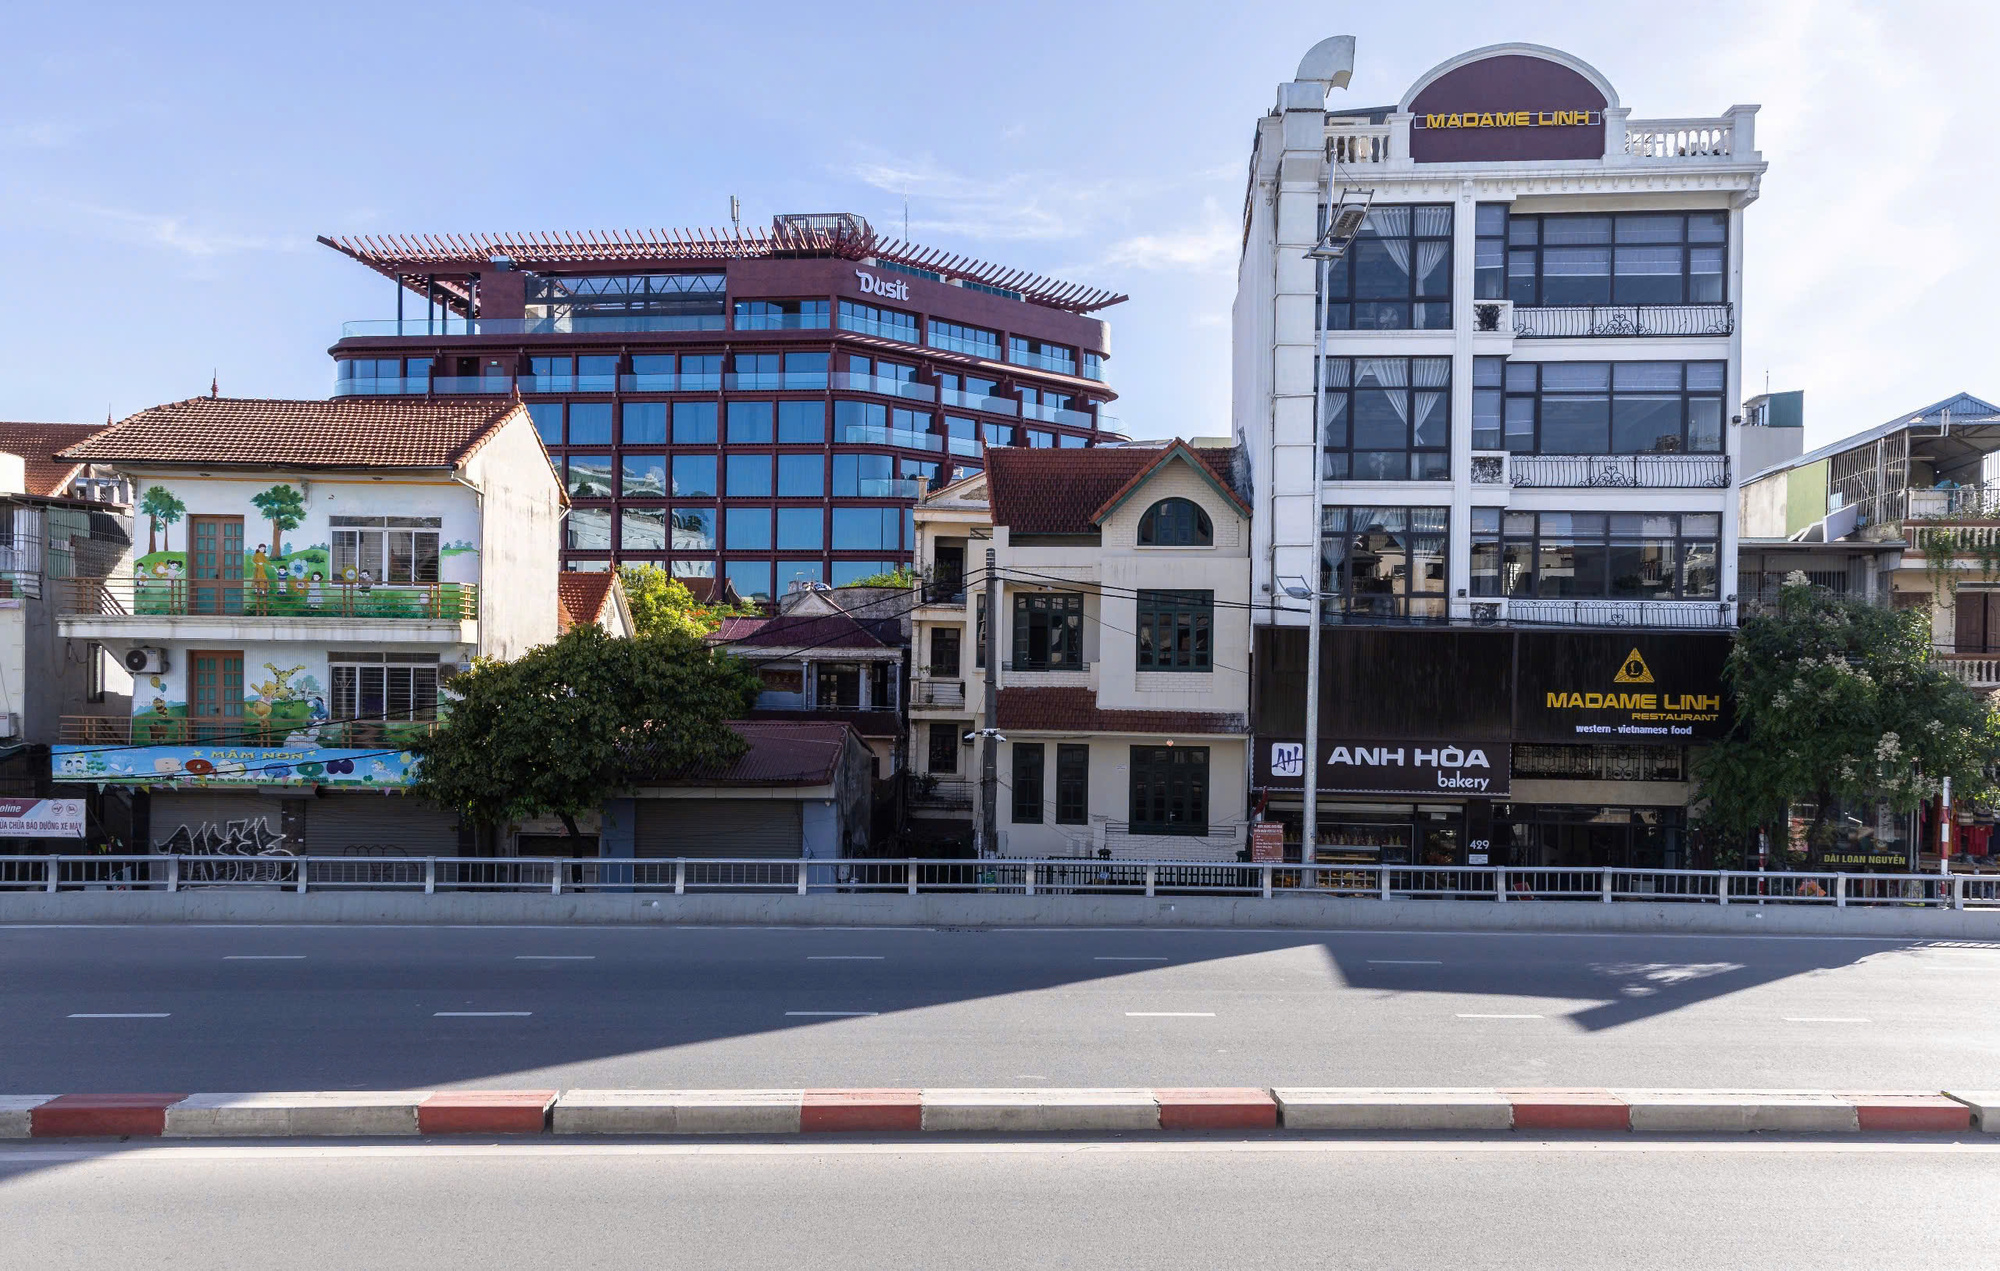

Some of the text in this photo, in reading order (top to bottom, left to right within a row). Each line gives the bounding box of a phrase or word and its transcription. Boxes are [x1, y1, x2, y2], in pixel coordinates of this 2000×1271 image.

[1426, 110, 1589, 128] MADAME LINH
[855, 269, 909, 301] Dusit
[1546, 692, 1720, 711] MADAME LINH
[1631, 712, 1719, 721] RESTAURANT
[1575, 724, 1611, 734] western
[1617, 724, 1668, 735] vietnamese
[1670, 725, 1692, 735] food
[1327, 745, 1490, 768] ANH HÒA
[1437, 770, 1489, 791] bakery
[60, 822, 69, 830] XE
[1470, 840, 1490, 850] 429
[1842, 855, 1866, 864] LOAN
